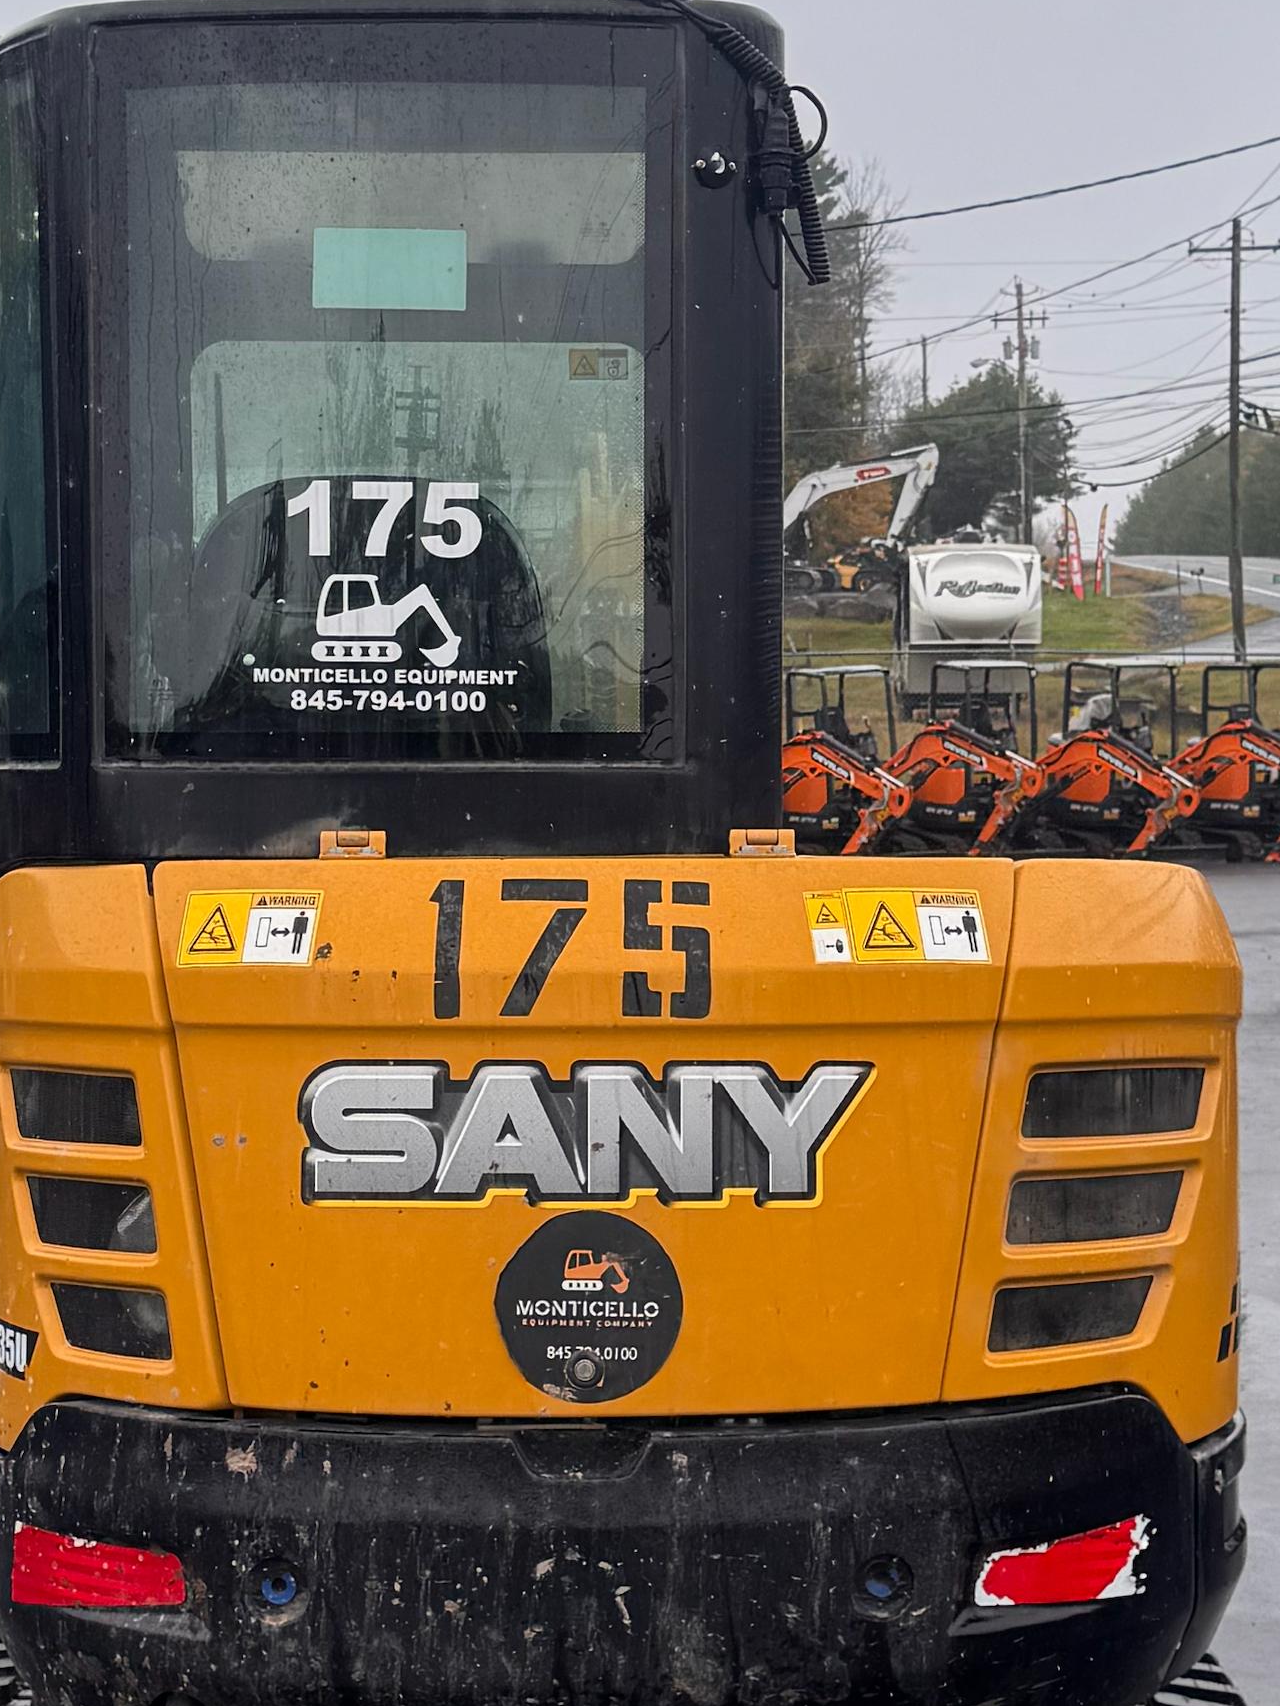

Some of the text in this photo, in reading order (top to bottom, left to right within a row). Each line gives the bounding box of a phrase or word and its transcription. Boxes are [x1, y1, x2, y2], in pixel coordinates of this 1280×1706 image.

[287, 479, 483, 559] 175
[934, 580, 1022, 598] Reflection
[252, 667, 518, 685] MONTICELLO EQUIPMENT
[290, 689, 487, 712] 845-794-0100
[269, 895, 316, 906] WARNING
[930, 895, 976, 906] WARNING
[429, 878, 711, 1020] 175
[302, 1061, 871, 1199] SANY
[516, 1300, 660, 1318] MONTICELLO
[522, 1319, 653, 1329] EQUIPMENT COMPANY
[546, 1346, 638, 1361] 8454.0100
